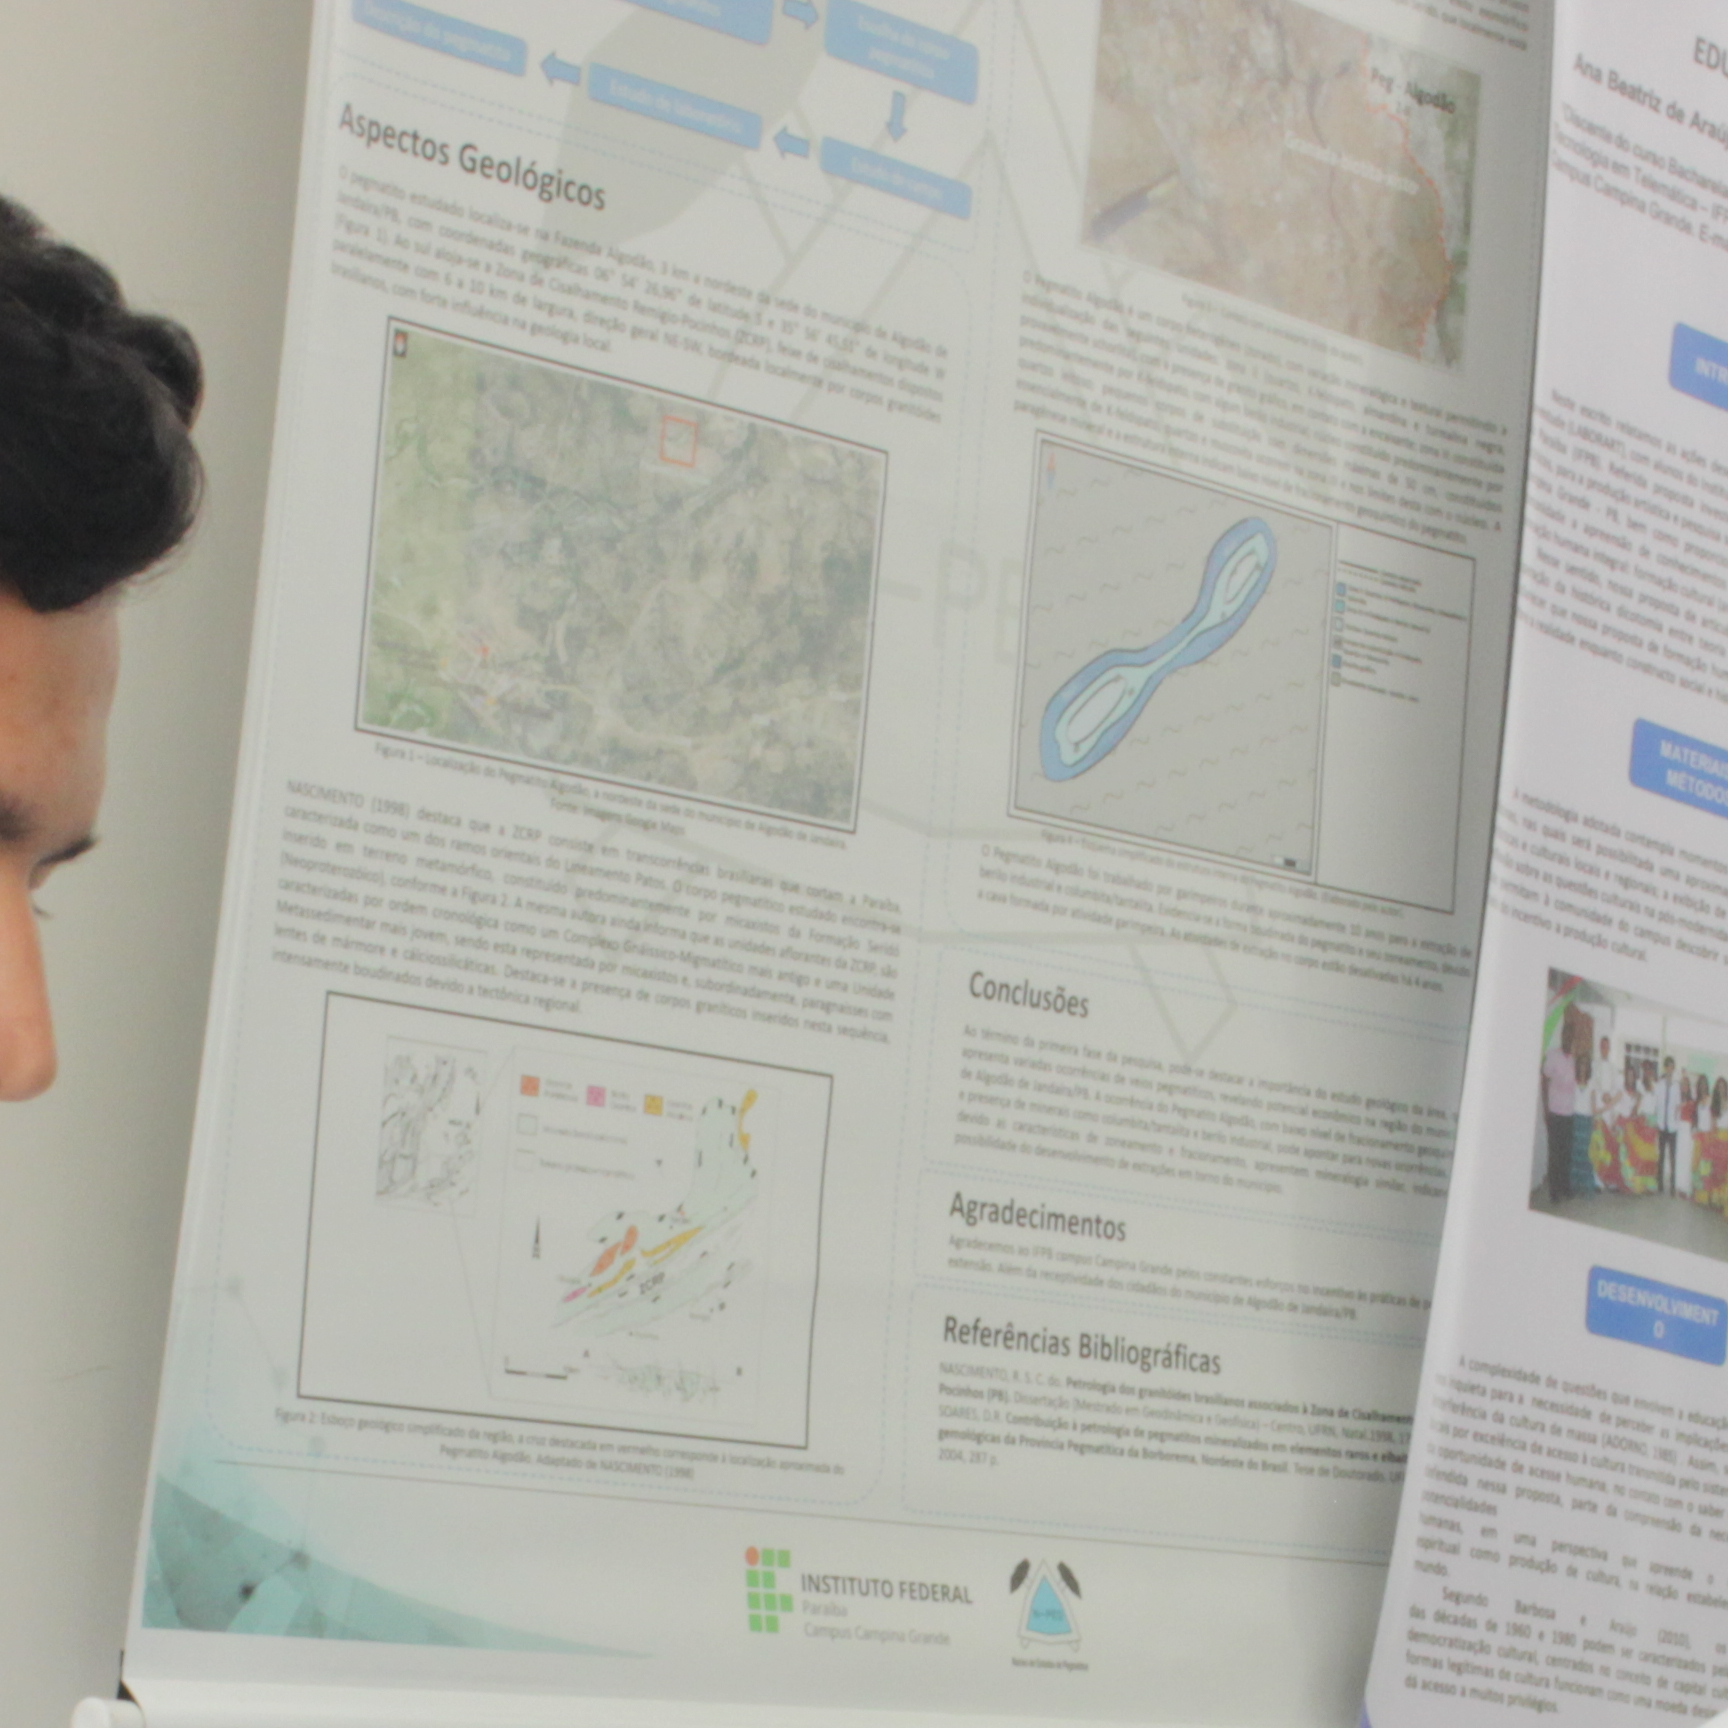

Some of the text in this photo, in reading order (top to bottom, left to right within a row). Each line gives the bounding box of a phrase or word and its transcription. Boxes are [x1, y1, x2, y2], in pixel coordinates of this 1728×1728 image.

[1574, 53, 1603, 84] Ana
[1607, 70, 1661, 113] Beatriz
[1666, 101, 1685, 124] de
[339, 104, 605, 209] Aspectos Geológicos
[969, 971, 1090, 1019] Conclusões
[950, 1192, 1127, 1242] Agradecimentos
[1597, 1279, 1720, 1326] DESENVOLVIMENT
[944, 1316, 1221, 1374] Referências Bibliográficas
[801, 1573, 973, 1605] INSTITUTO FEDERAL
[803, 1600, 848, 1617] Paraíba
[804, 1622, 951, 1645] Campus Campina Grande
